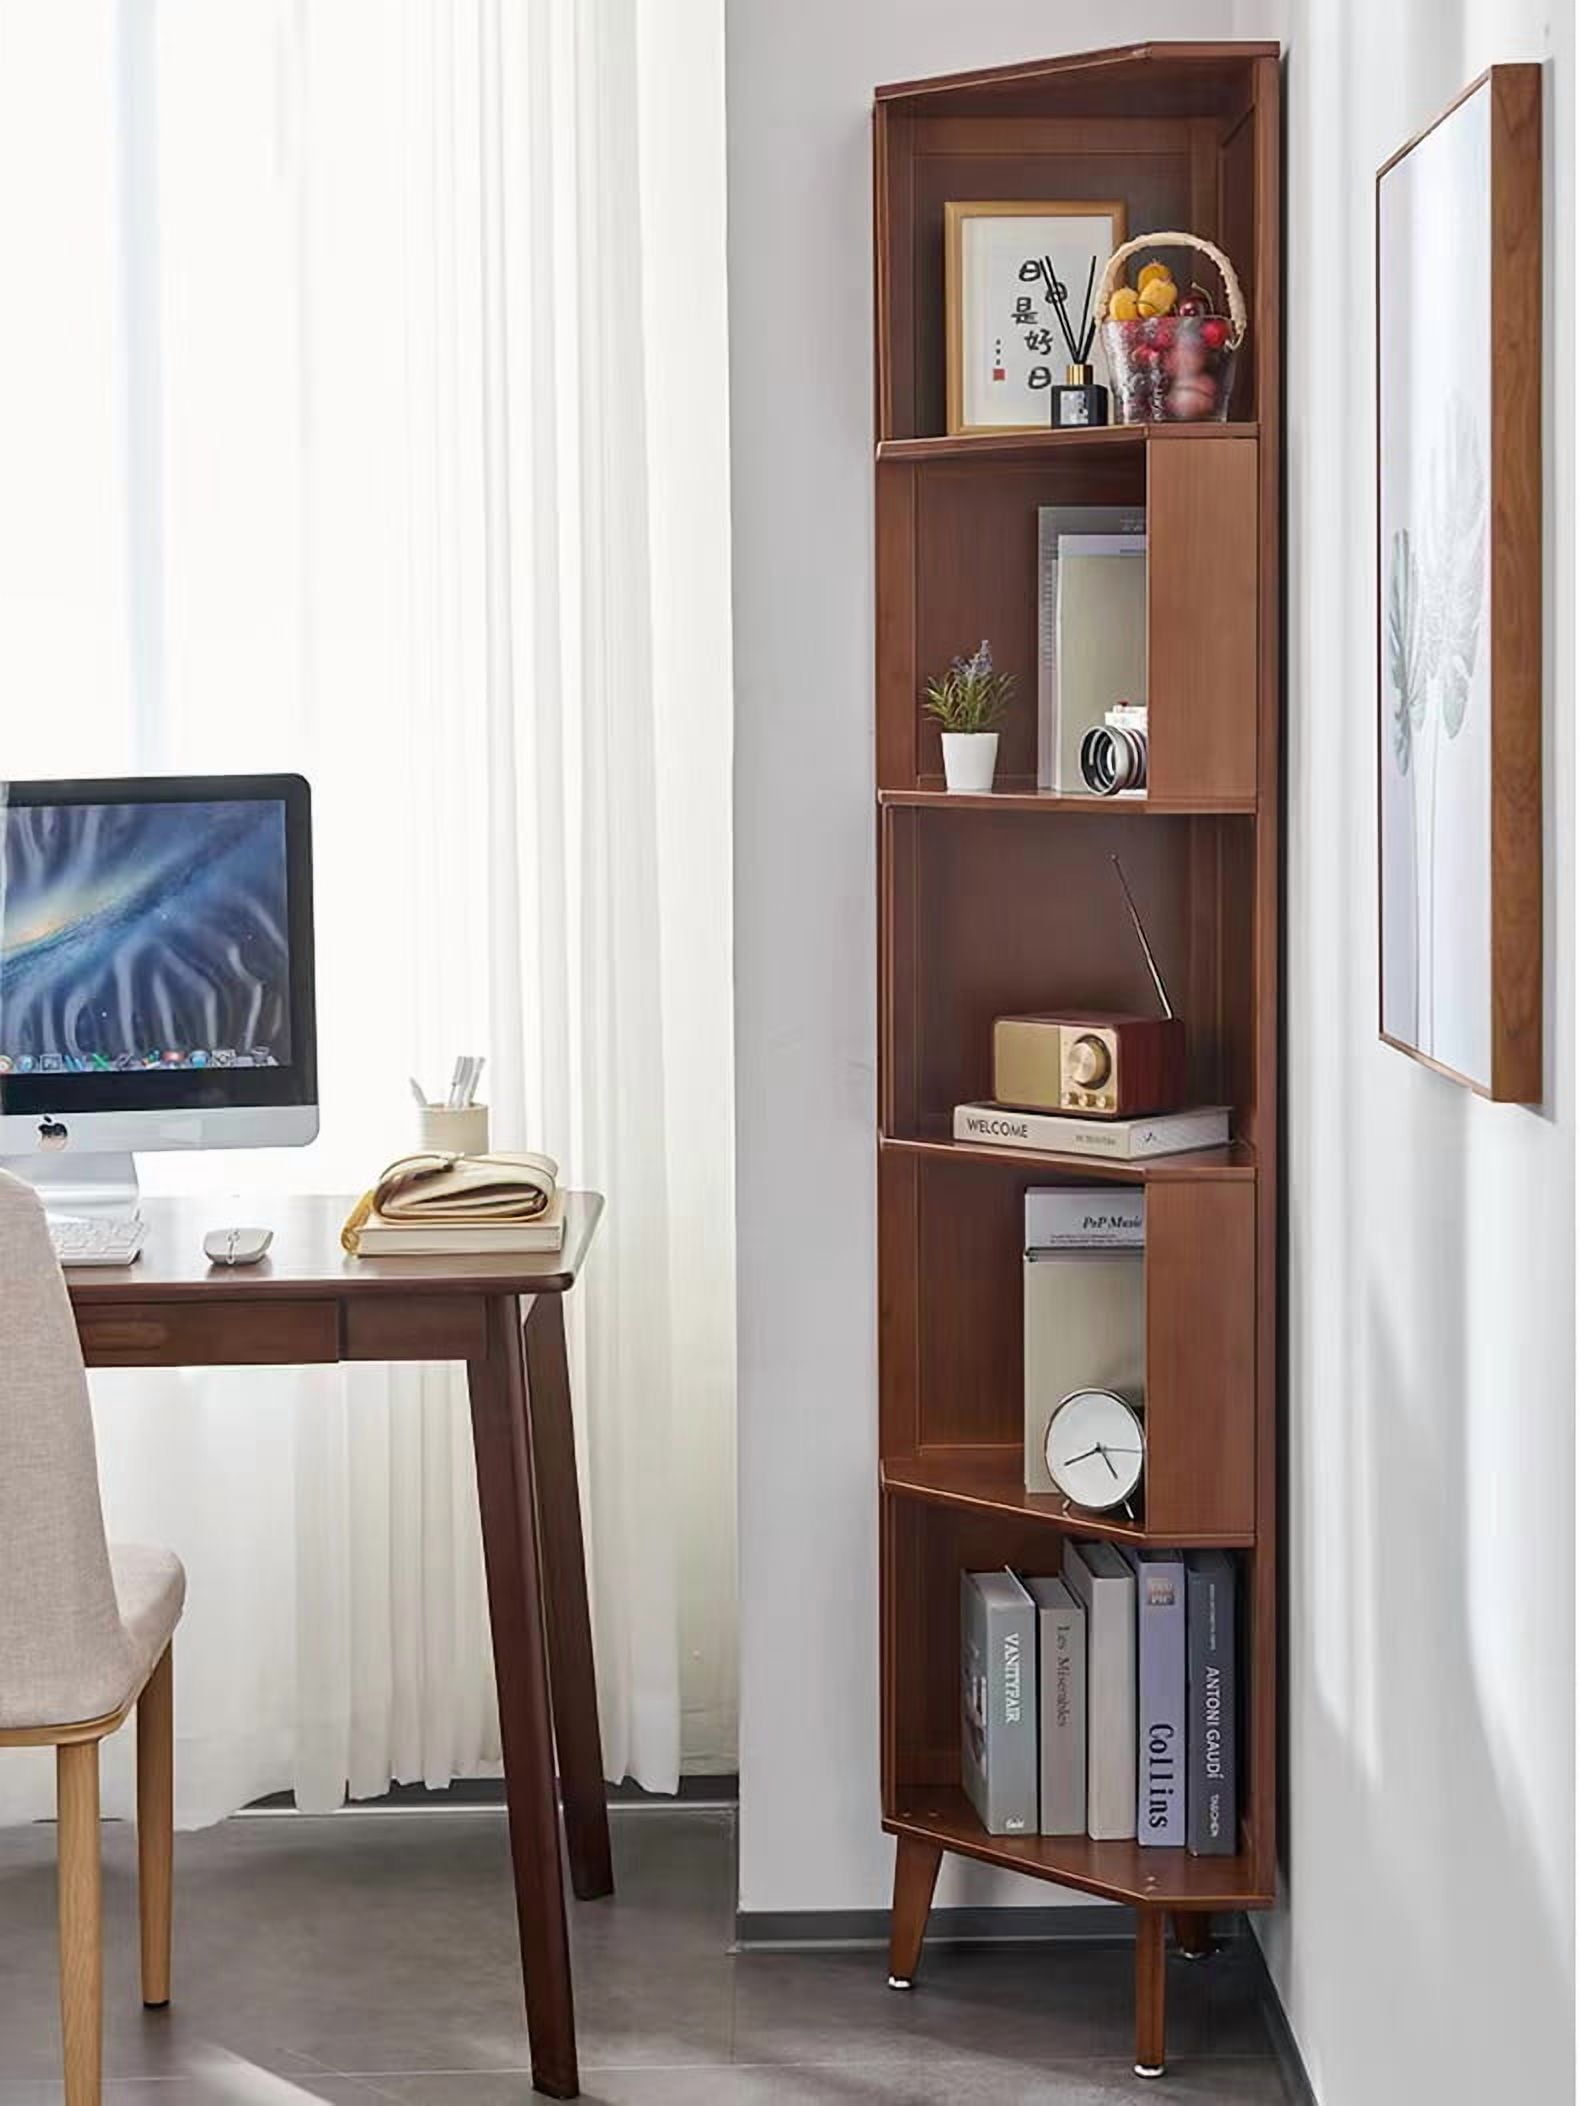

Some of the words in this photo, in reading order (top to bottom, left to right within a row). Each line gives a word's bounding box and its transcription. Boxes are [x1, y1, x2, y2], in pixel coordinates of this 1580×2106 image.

[966, 1117, 1028, 1139] WELCOME
[1205, 1665, 1220, 1725] ANTONI
[1148, 1723, 1175, 1829] Collins
[1205, 1726, 1225, 1780] GAUDÍ
